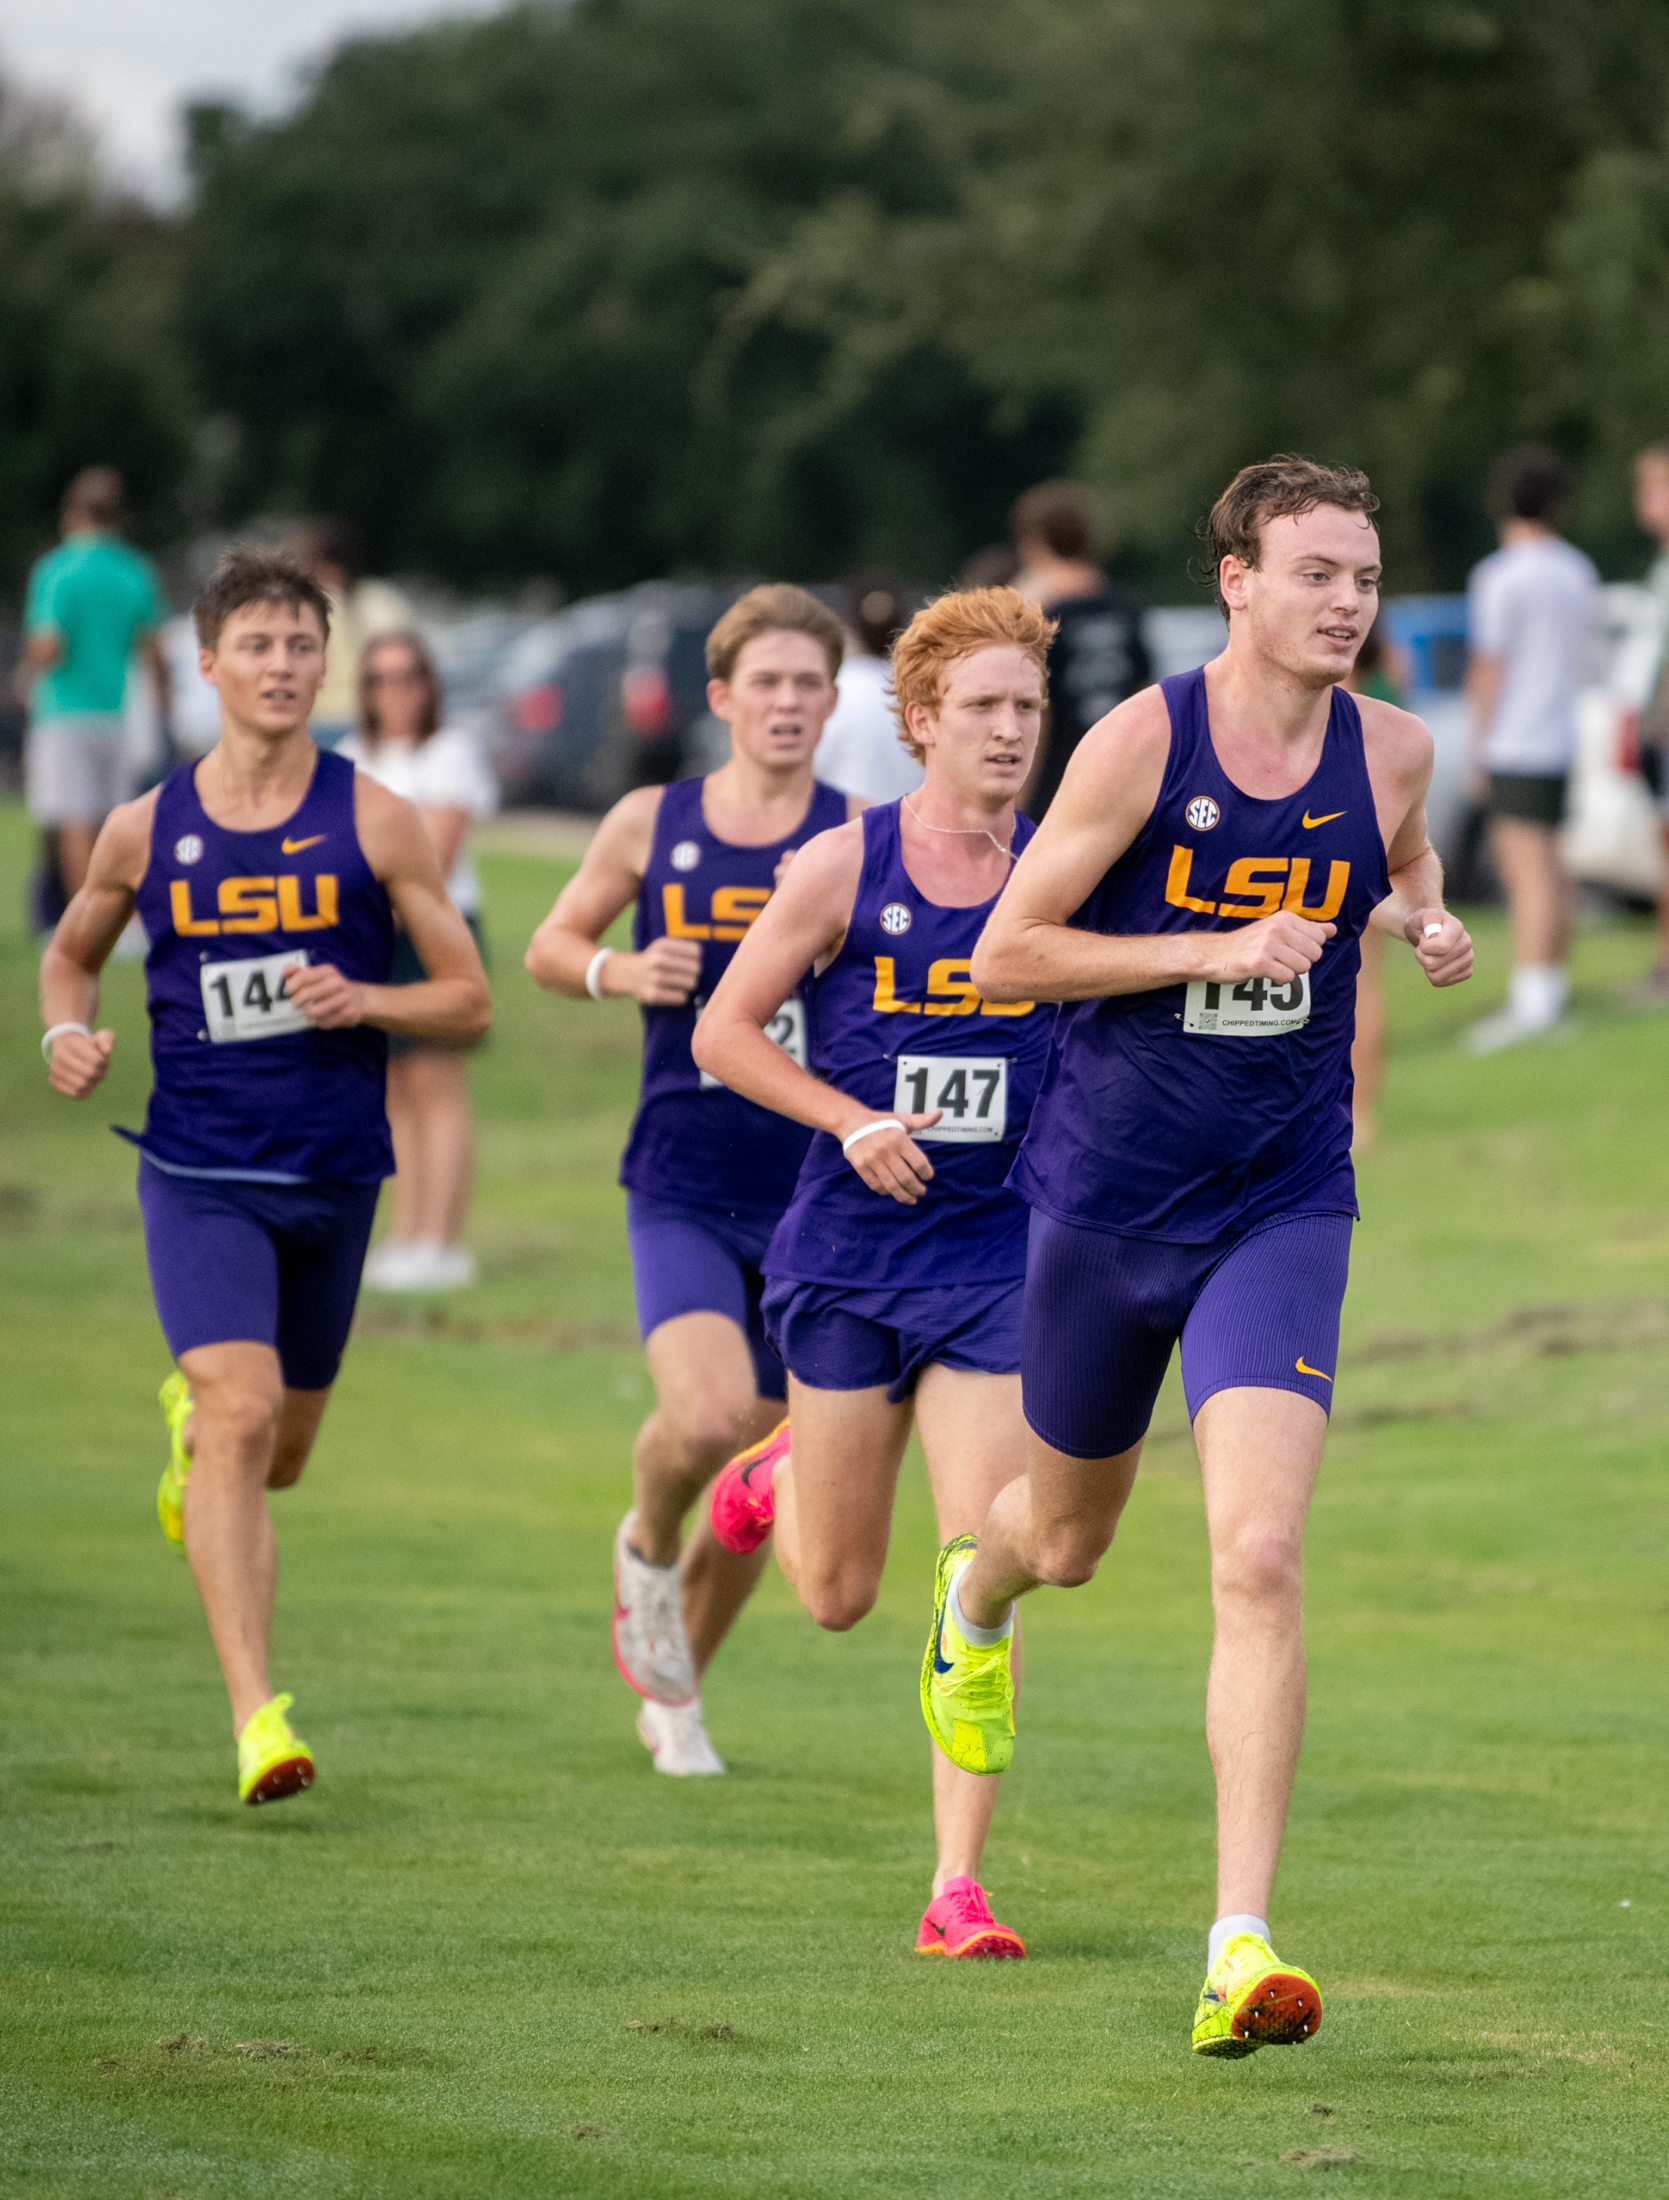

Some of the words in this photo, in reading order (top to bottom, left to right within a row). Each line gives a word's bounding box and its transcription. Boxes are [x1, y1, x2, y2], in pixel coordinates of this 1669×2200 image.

[1188, 798, 1217, 829] SEC
[170, 874, 339, 937] LSU
[1165, 844, 1350, 921] LSU
[663, 883, 772, 942] LS
[882, 904, 909, 933] SEC
[873, 956, 1035, 1016] LS
[904, 1066, 1000, 1118] 147
